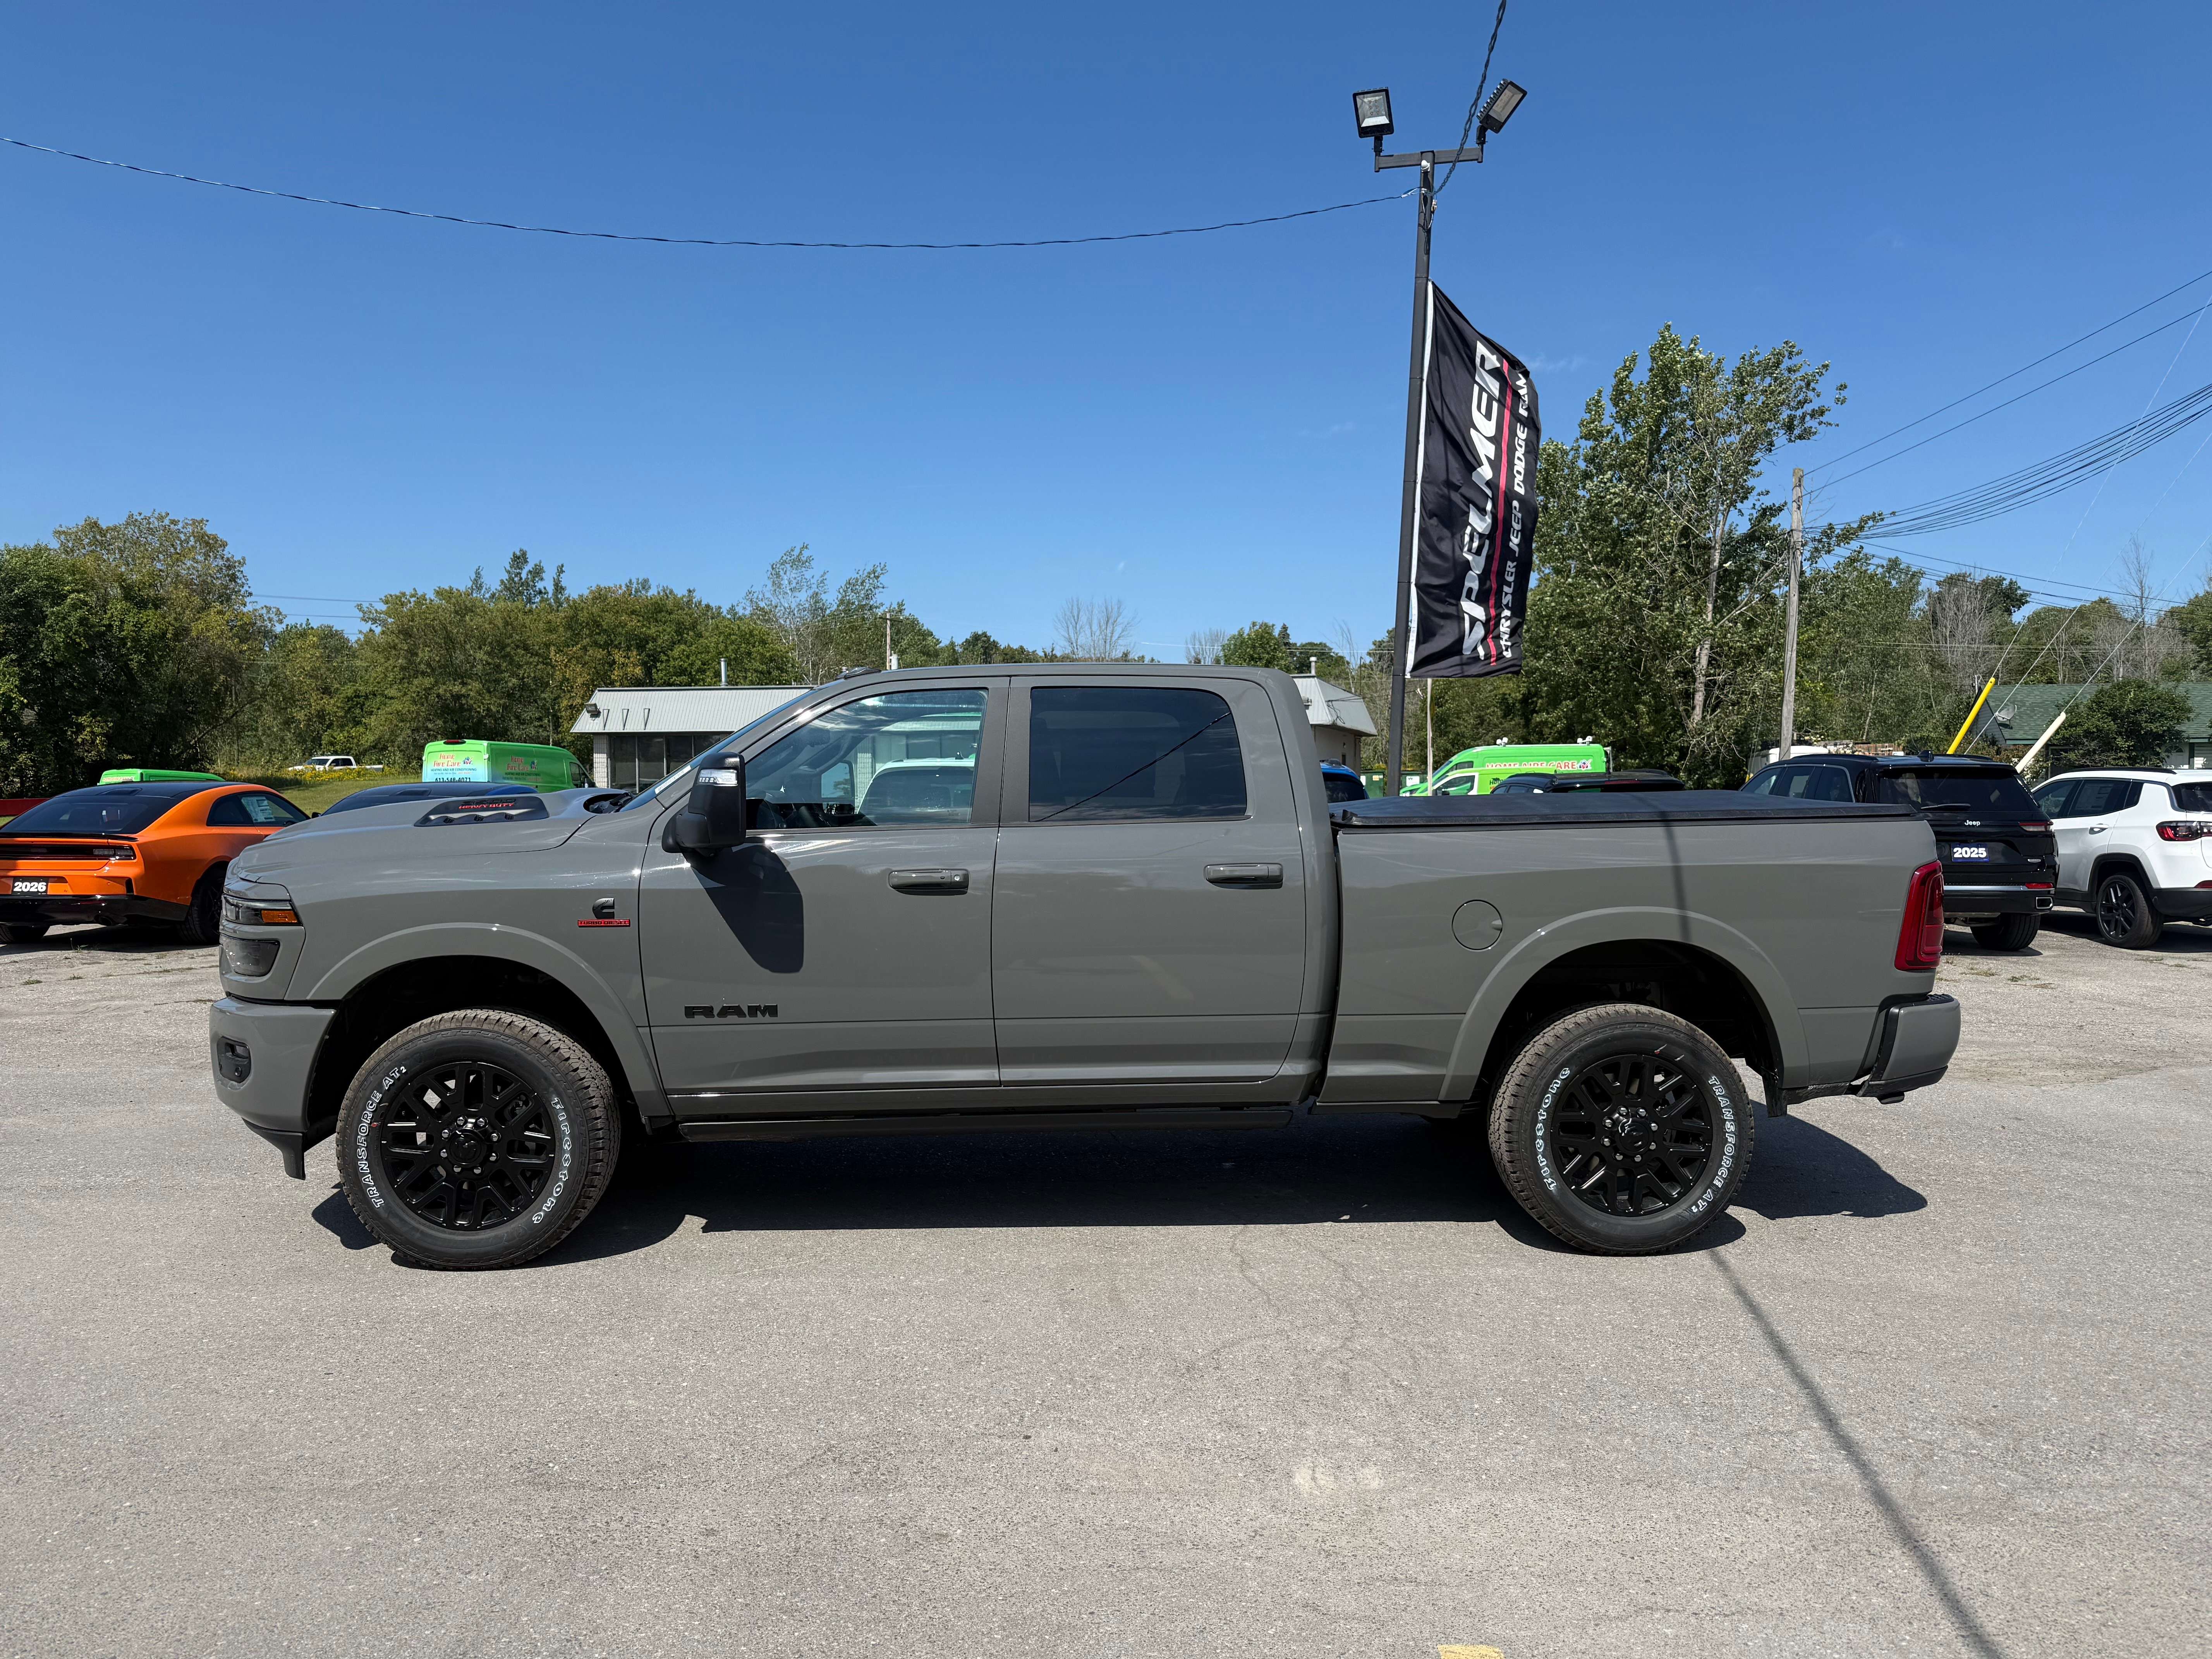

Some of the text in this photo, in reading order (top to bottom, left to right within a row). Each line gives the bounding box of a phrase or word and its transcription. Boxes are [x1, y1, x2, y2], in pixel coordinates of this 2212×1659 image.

[1460, 340, 1501, 660] SPELMER
[1499, 373, 1528, 658] CHRYSLER JEEP DODGE RAM
[13, 882, 46, 892] 2026
[1953, 847, 1987, 858] 2025
[684, 1004, 778, 1018] RAM
[357, 1090, 384, 1208] TRANSFORCE
[532, 1098, 572, 1223] Firestone
[1535, 1068, 1570, 1190] Firestone
[1708, 1077, 1735, 1188] TRANSFORCE
